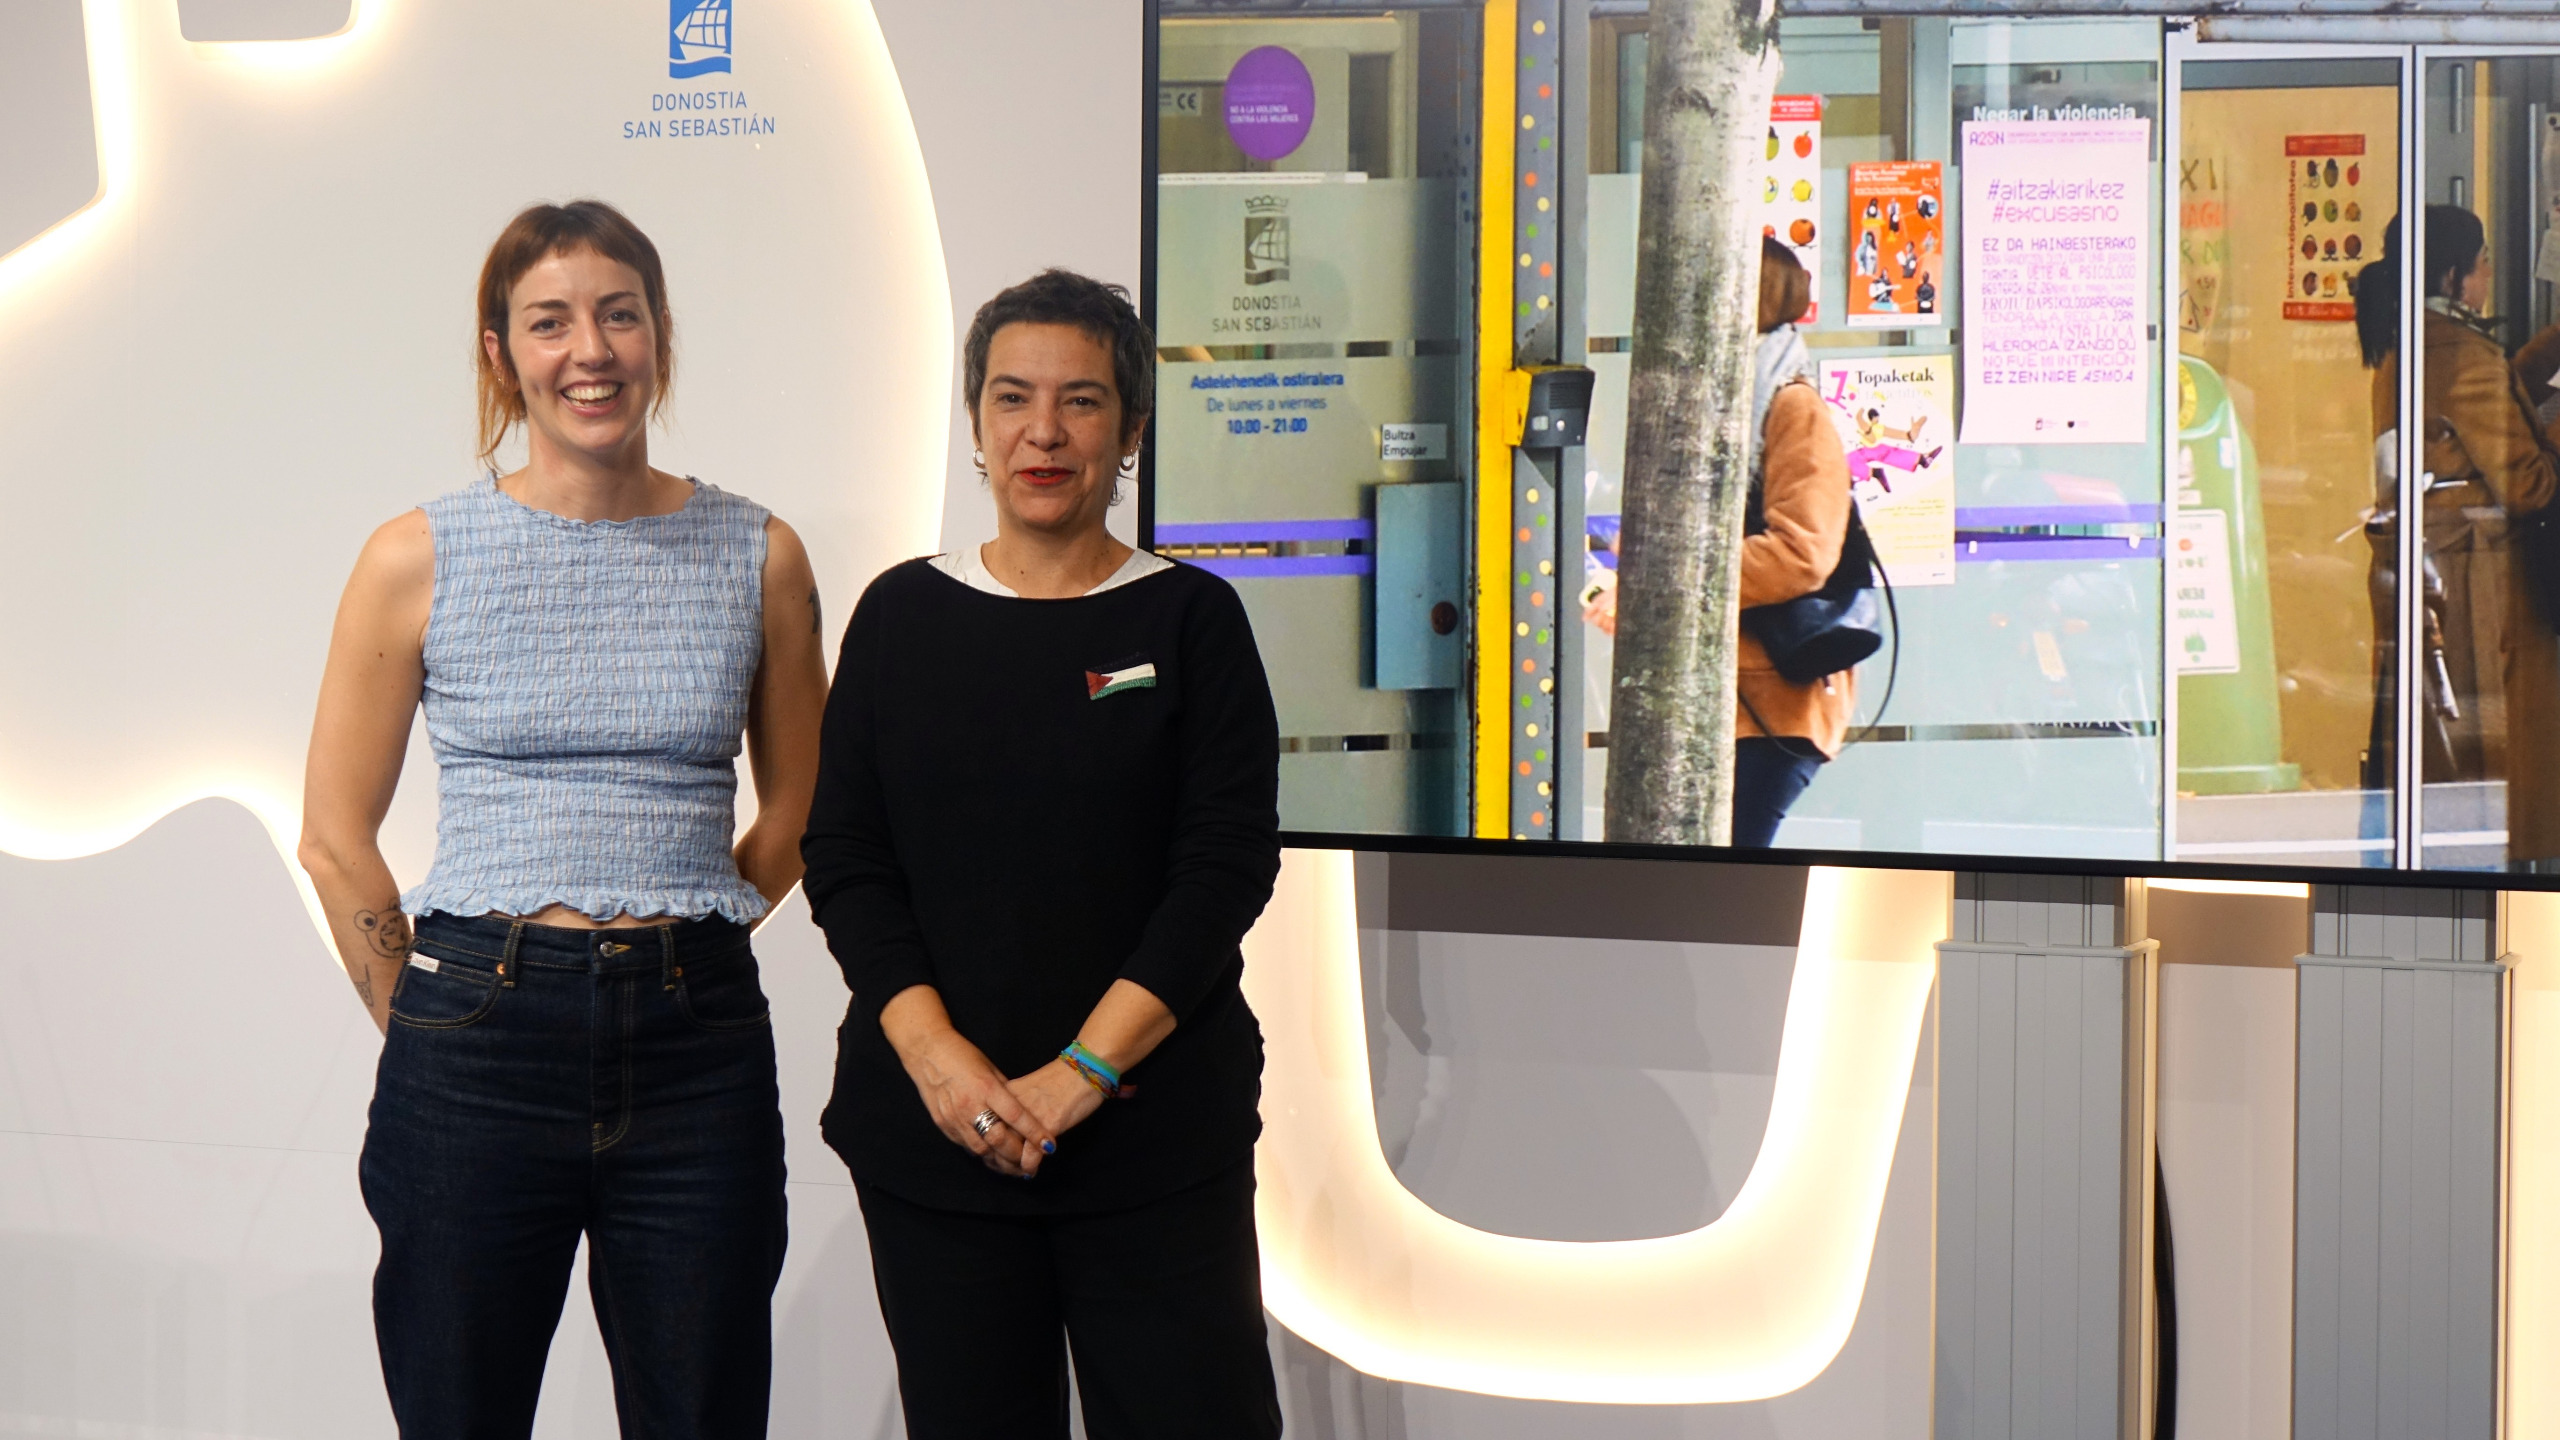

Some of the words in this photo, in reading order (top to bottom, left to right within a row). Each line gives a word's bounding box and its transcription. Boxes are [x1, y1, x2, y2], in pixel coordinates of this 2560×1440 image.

[652, 91, 747, 112] DONOSTIA
[2033, 105, 2050, 121] la
[2054, 103, 2136, 120] violencia
[623, 120, 661, 139] SAN
[669, 113, 775, 137] SEBASTIÁN
[1987, 178, 2125, 200] #aitzakiarikez
[1992, 201, 2120, 223] #excusasno
[1982, 238, 1999, 251] EZ
[2007, 238, 2024, 251] DA
[2031, 236, 2137, 251] HAINBESTERAKO
[1232, 295, 1302, 312] DONOSTIA
[1212, 318, 1241, 333] SAN
[1190, 373, 1280, 390] Astelehenetik
[1282, 371, 1345, 388] ostiralera
[1855, 367, 1935, 387] Topaketak
[1983, 371, 2004, 384] EZ
[1207, 397, 1224, 413] De
[1227, 397, 1264, 412] lunes
[1267, 400, 1276, 411] a
[1279, 396, 1327, 411] viernes
[1384, 429, 1416, 442] Bultza
[1383, 445, 1428, 458] Empujar
